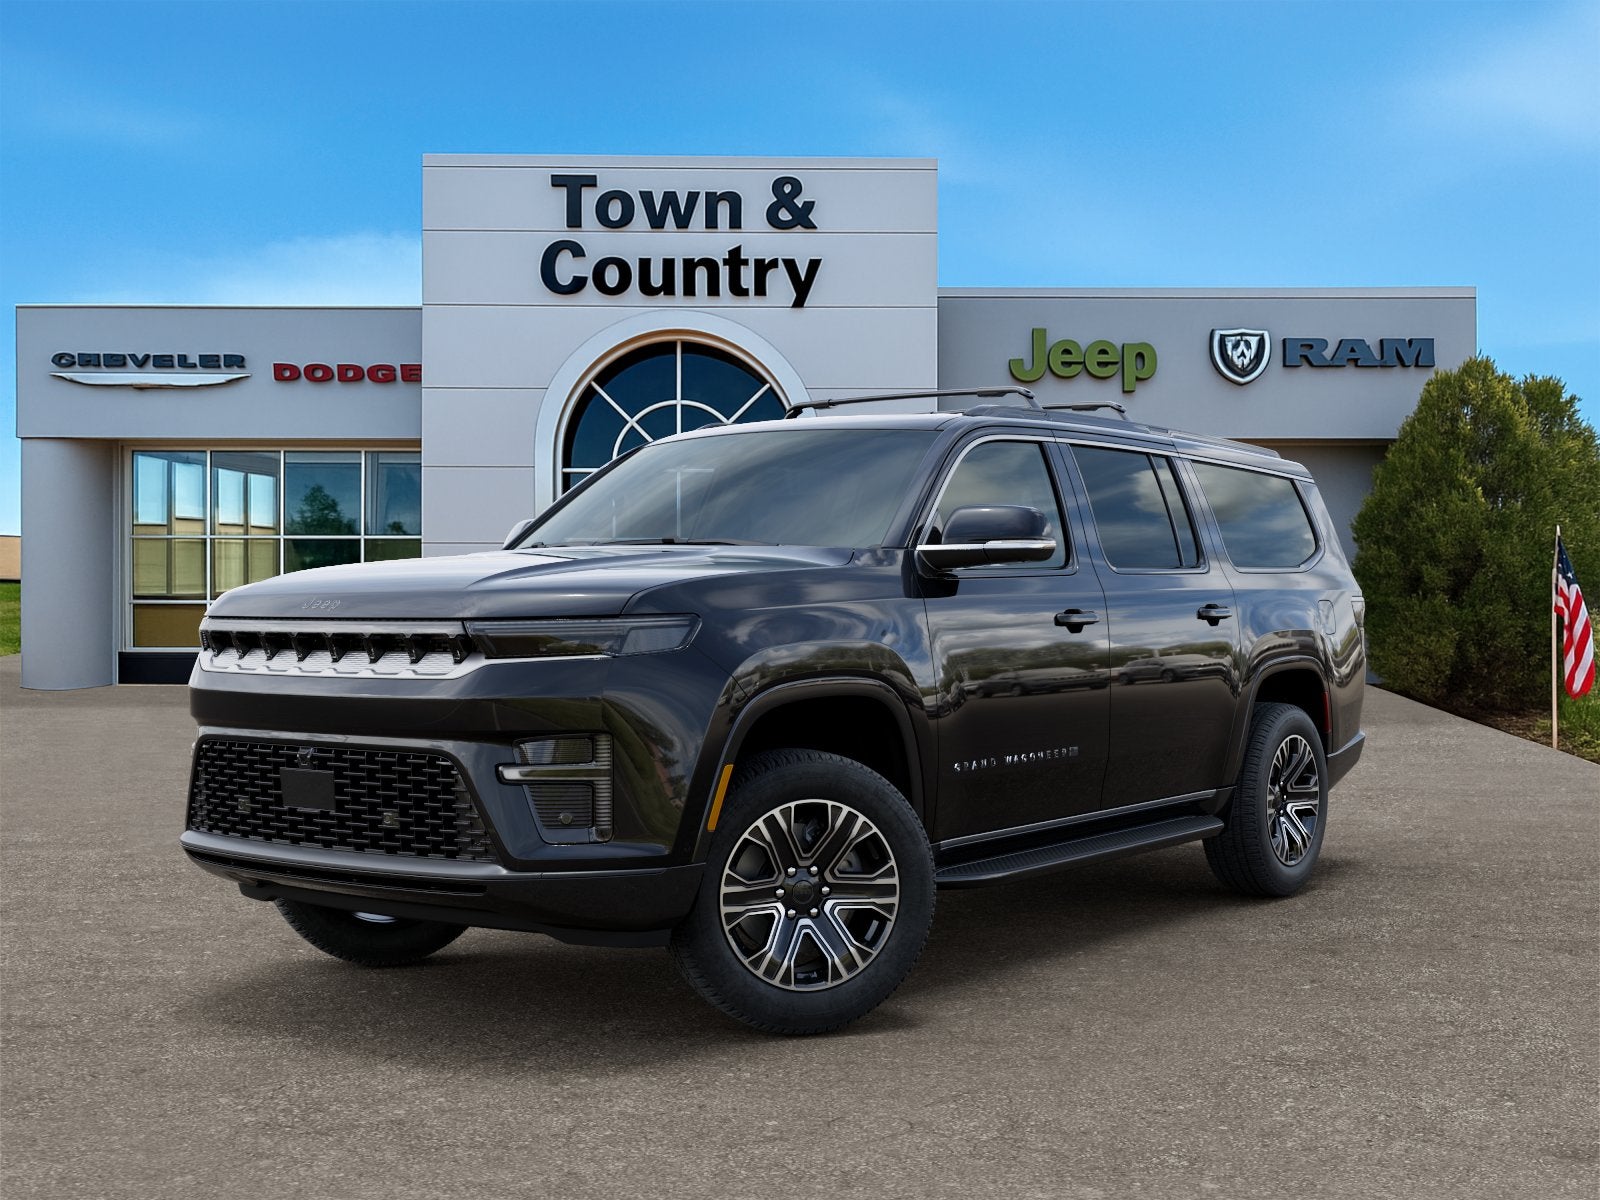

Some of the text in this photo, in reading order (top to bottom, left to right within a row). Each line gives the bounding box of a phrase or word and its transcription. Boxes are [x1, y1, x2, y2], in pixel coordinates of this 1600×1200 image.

[550, 174, 818, 230] Town &
[540, 239, 823, 308] Country
[273, 362, 422, 384] DODGE
[1009, 328, 1158, 393] Jeep
[1283, 337, 1436, 368] RAM
[301, 597, 341, 612] Jeep
